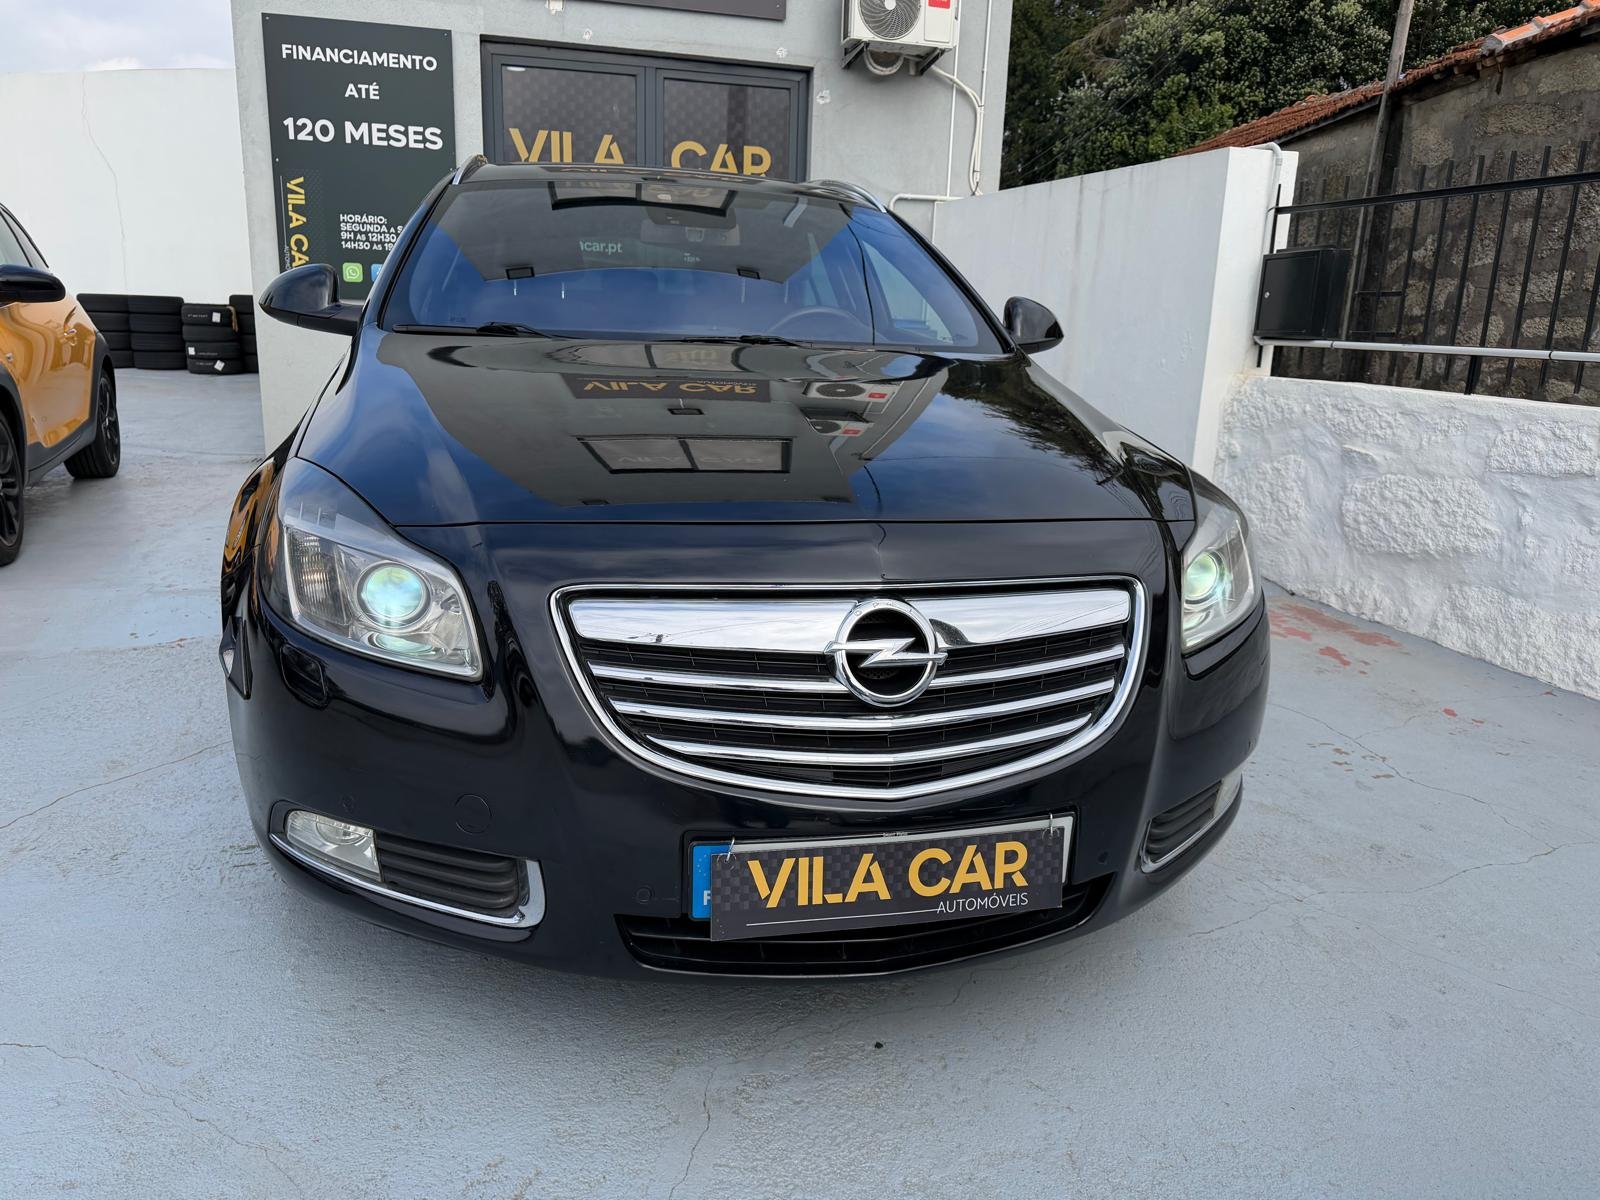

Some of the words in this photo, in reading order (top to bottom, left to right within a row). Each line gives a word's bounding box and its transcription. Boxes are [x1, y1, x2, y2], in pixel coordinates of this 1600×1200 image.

[281, 44, 438, 71] FINANCIAMENTO
[344, 82, 380, 100] ATÉ
[283, 117, 335, 143] 120
[344, 121, 443, 150] MESES
[671, 140, 772, 177] CAR
[287, 177, 307, 228] VILA
[340, 213, 388, 224] HORÁRIO:
[340, 223, 388, 233] SEGUNDA
[397, 226, 403, 234] S
[340, 231, 354, 240] 9H
[368, 233, 397, 242] 12H30
[341, 241, 371, 250] 14H30
[290, 233, 310, 268] CA
[747, 852, 892, 908] VILA
[908, 840, 1029, 897] CAR
[936, 892, 1029, 914] AUTOMÓVEIS
